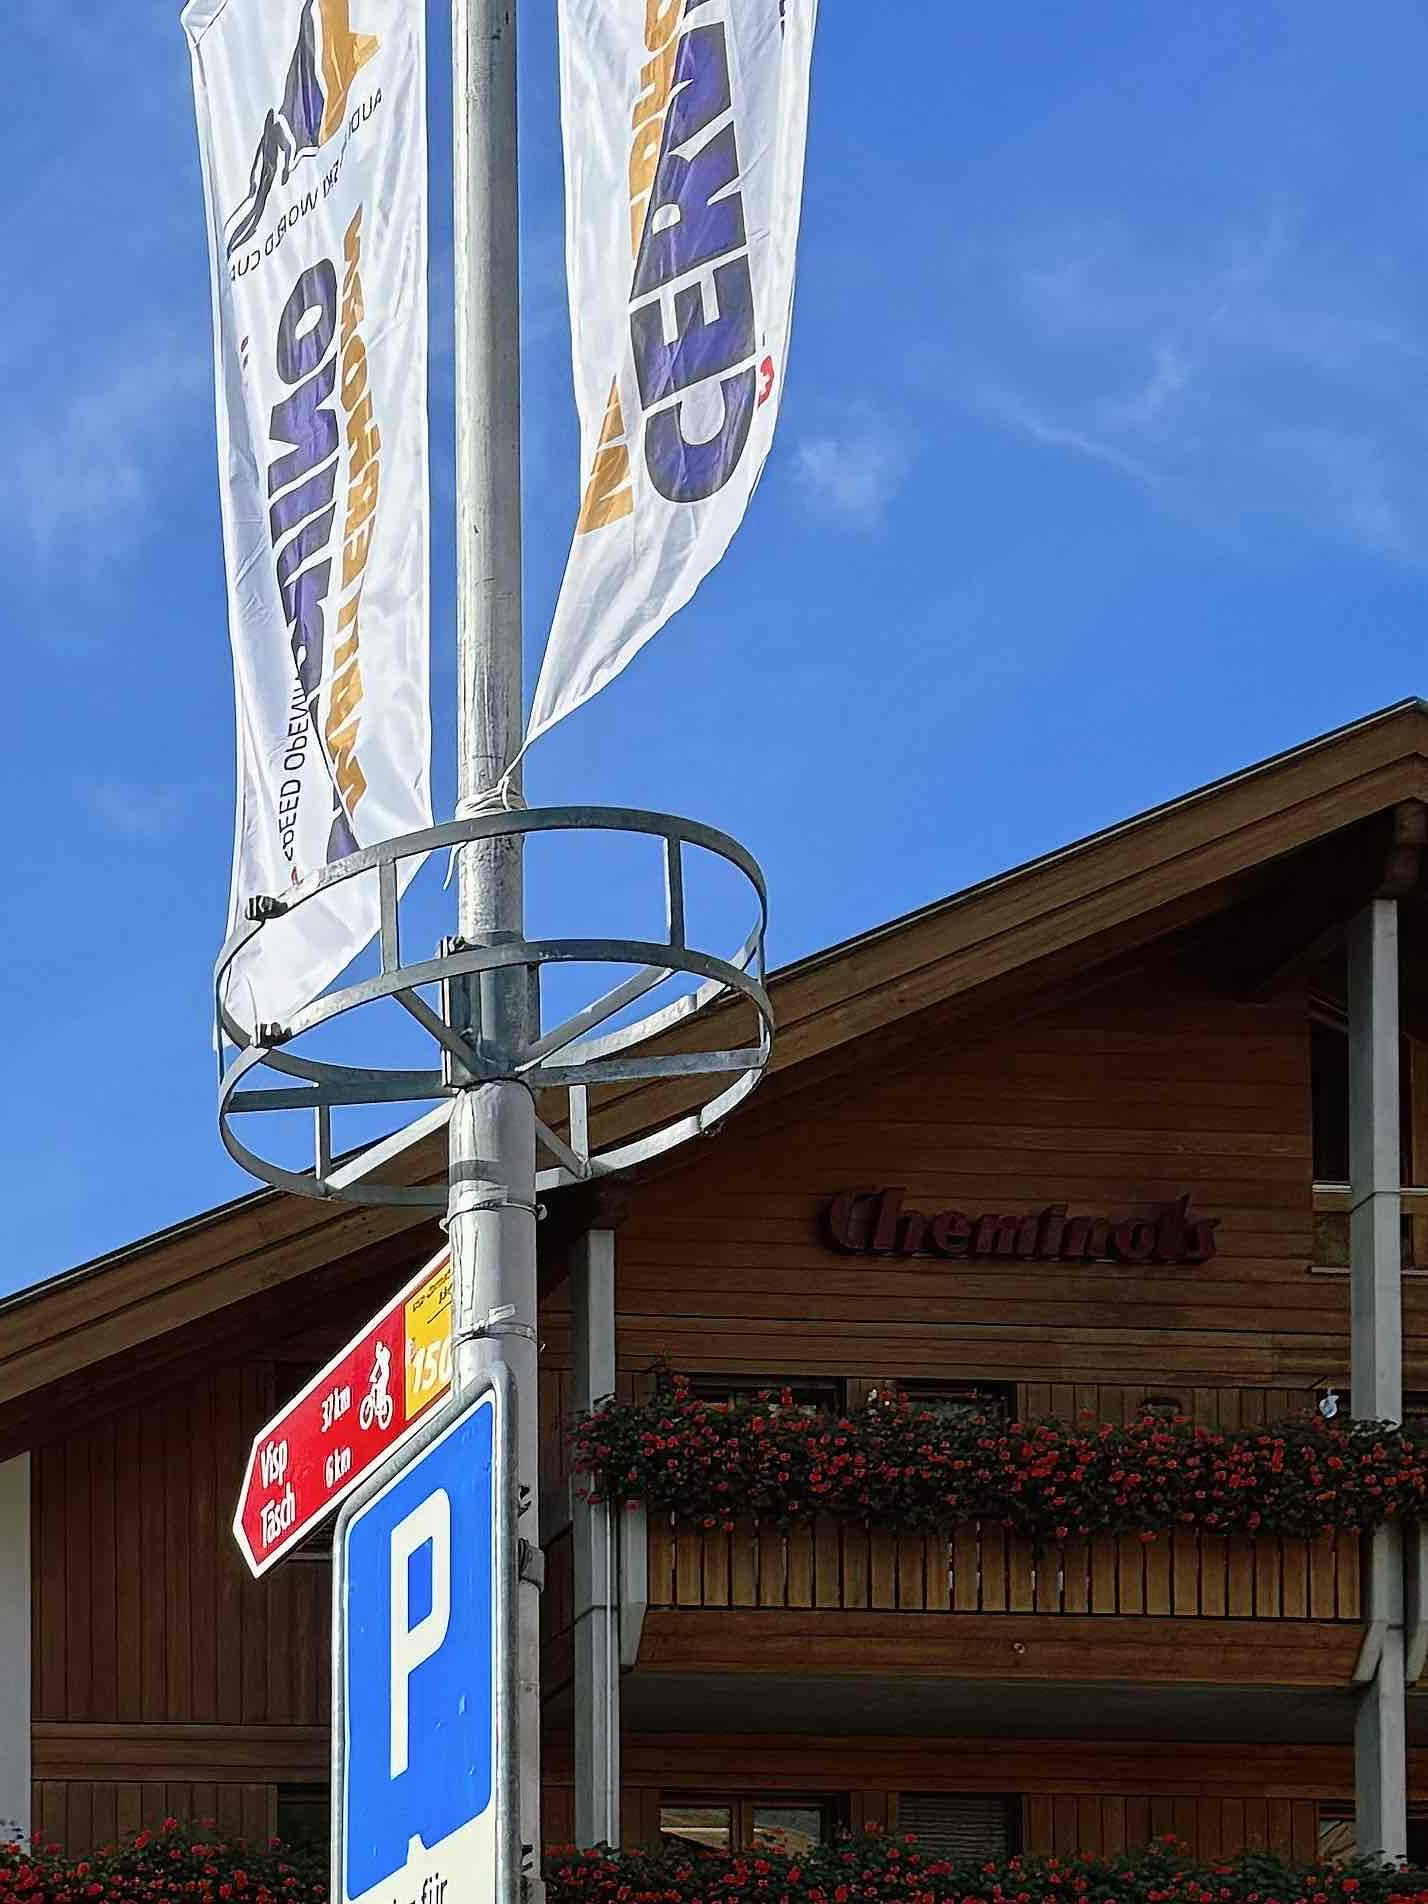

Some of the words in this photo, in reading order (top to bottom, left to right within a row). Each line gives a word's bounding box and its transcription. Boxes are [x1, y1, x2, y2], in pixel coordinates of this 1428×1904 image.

[629, 0, 760, 503] CERV
[260, 1440, 288, 1489] Visp
[390, 1487, 452, 1782] P
